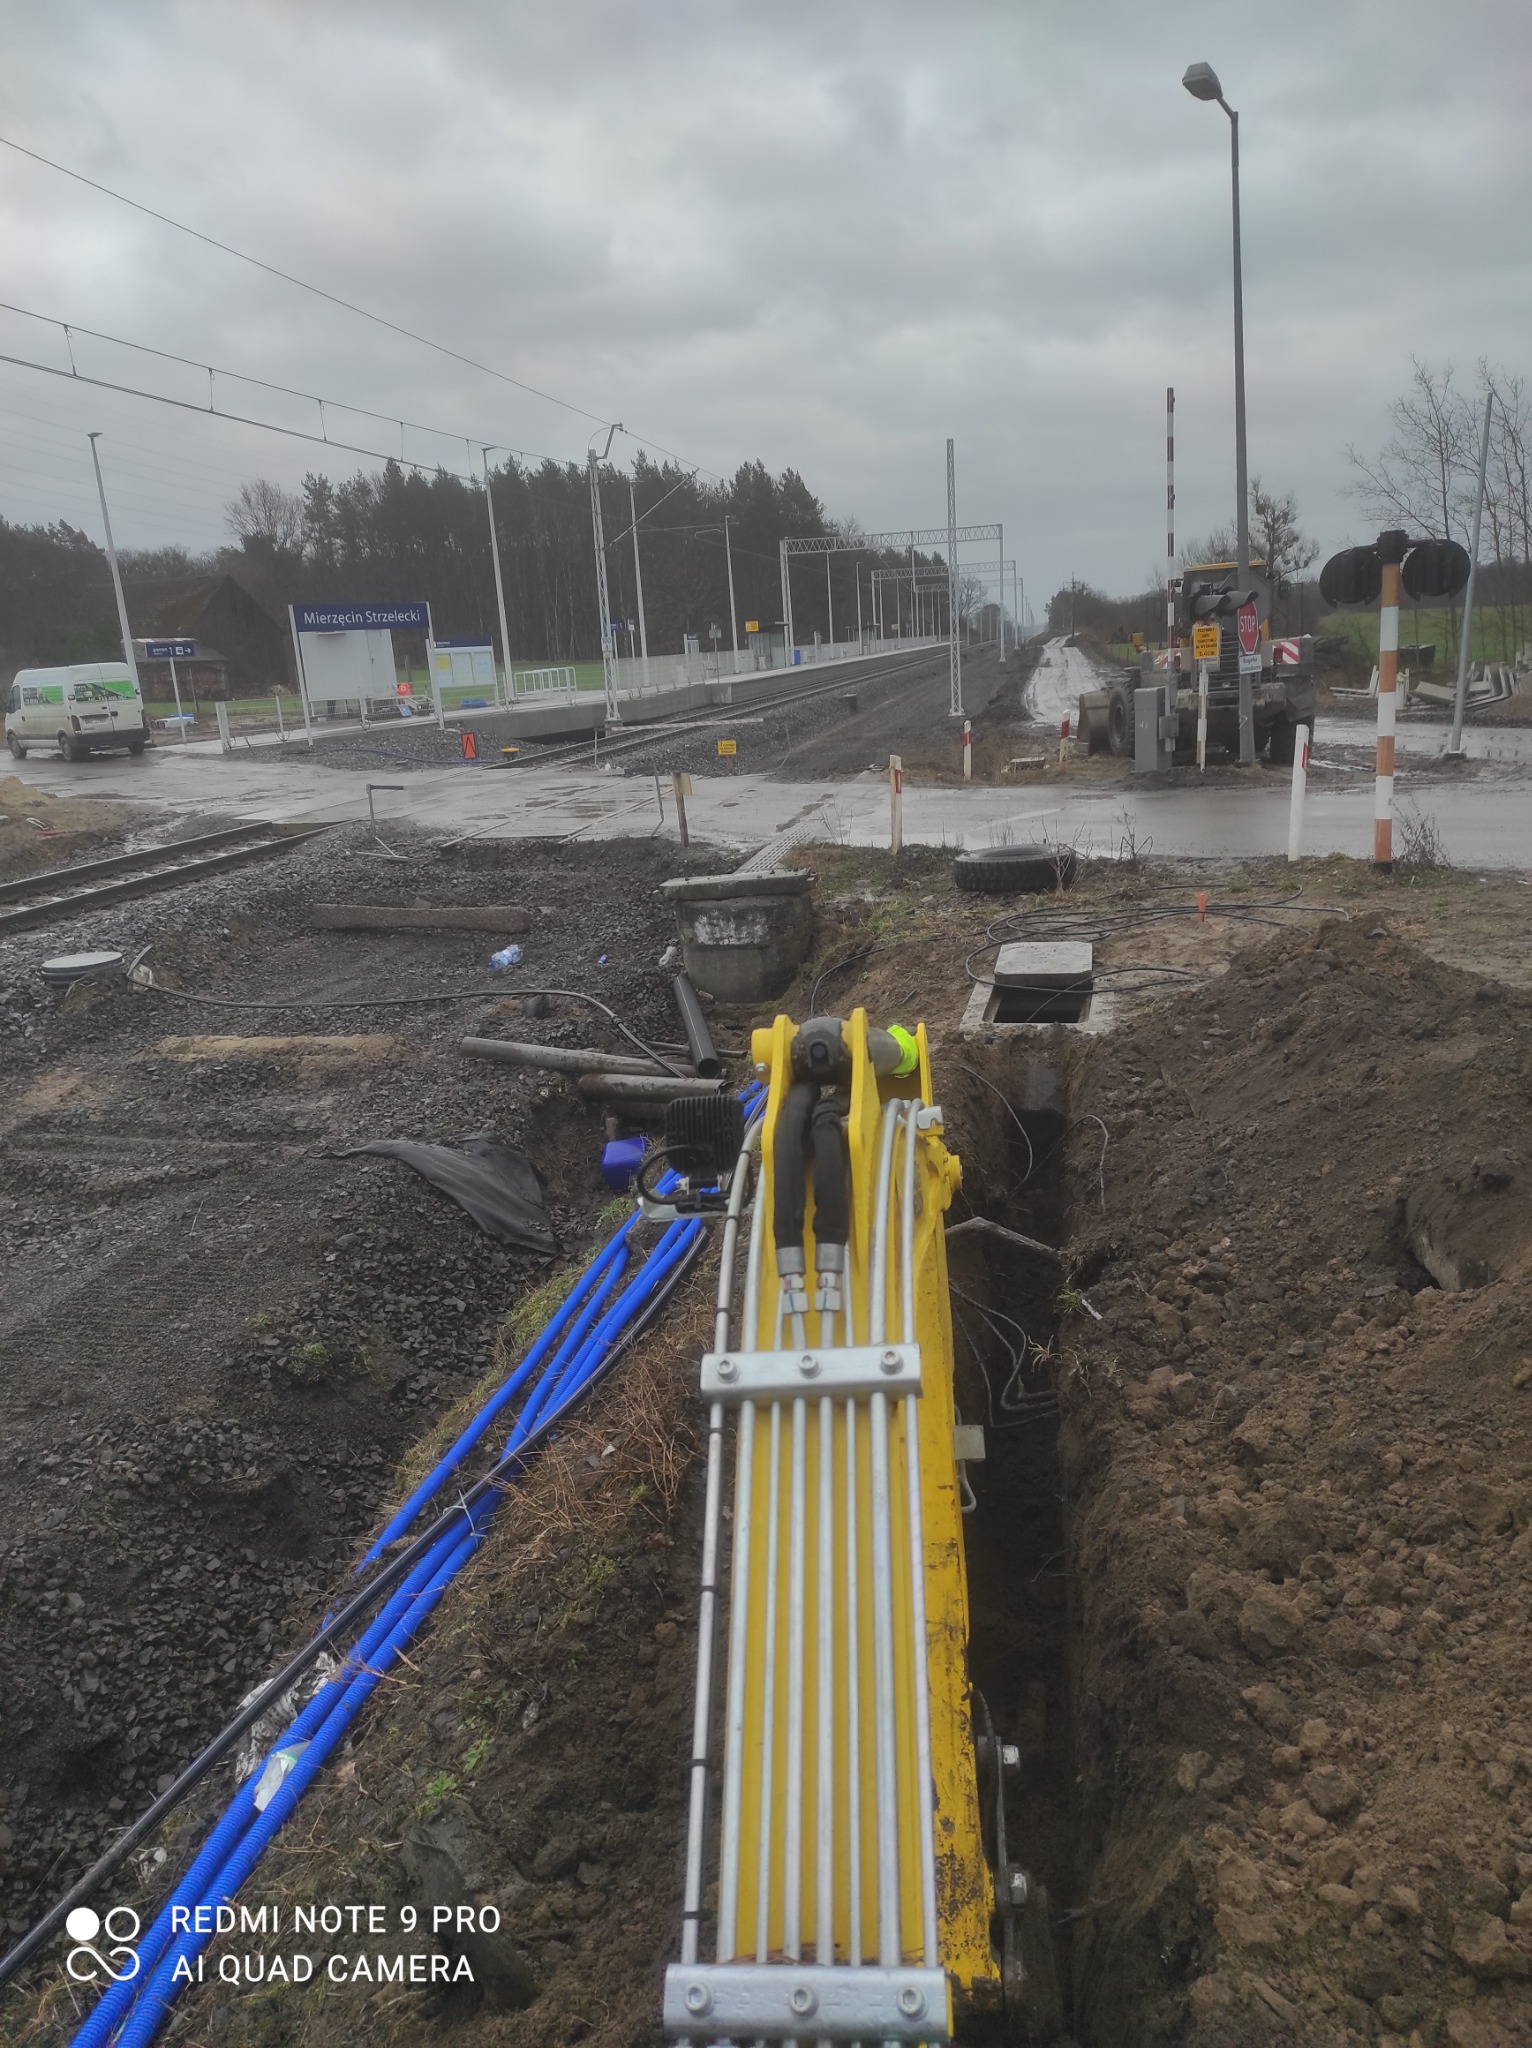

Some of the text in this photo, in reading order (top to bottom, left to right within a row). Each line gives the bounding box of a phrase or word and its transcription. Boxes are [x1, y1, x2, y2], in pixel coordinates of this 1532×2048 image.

[304, 609, 421, 626] Mierzęcin Strzelecki
[1240, 615, 1256, 633] STOP
